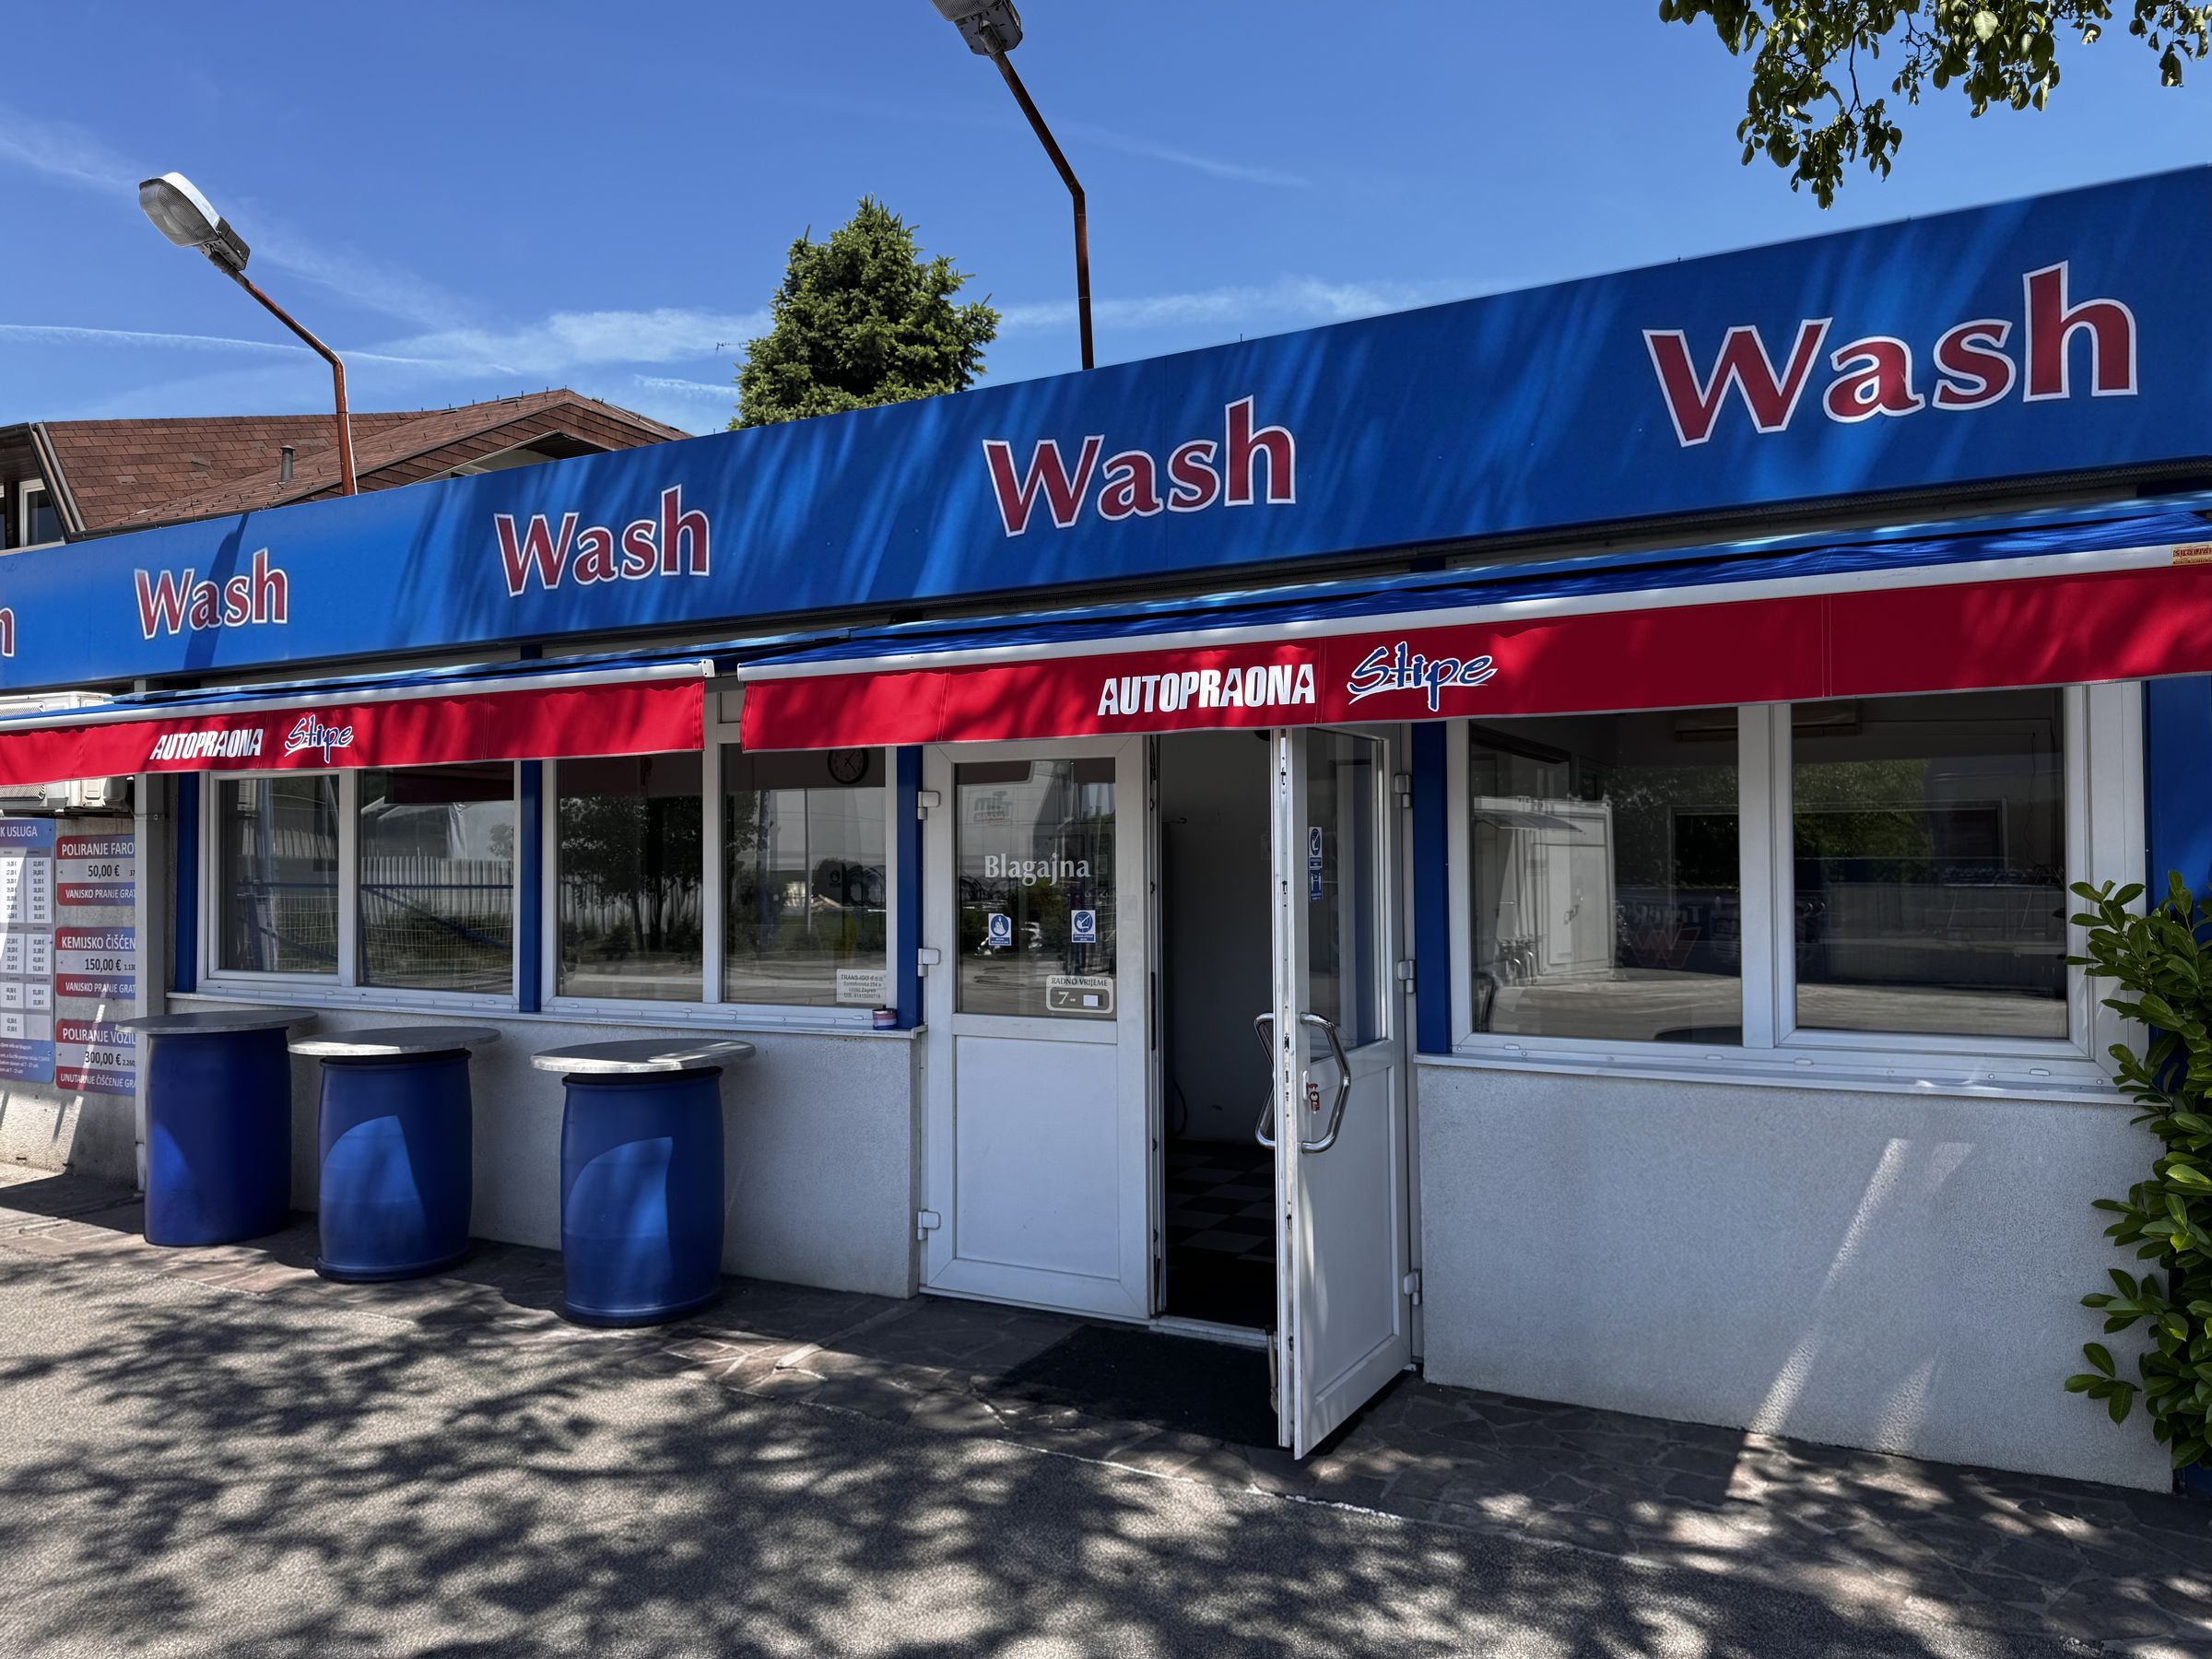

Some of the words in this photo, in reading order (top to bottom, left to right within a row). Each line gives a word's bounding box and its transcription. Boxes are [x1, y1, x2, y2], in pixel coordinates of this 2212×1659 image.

[1642, 261, 2138, 448] Wash
[982, 394, 1296, 537] Wash
[494, 484, 710, 597] Wash
[134, 547, 288, 640] Wash
[1098, 664, 1316, 716] AUTOPRAONA
[1347, 641, 1499, 712] Stipe
[149, 728, 264, 760] AUTOPRAONA
[284, 714, 354, 764] Stipe
[6, 826, 38, 838] USLUGA
[62, 842, 108, 856] POLIRANJE
[111, 841, 135, 855] FARO
[88, 865, 112, 878] 50,00
[114, 865, 120, 877] €
[984, 853, 1092, 887] Blagajna
[65, 888, 93, 899] VANJSKO
[94, 888, 119, 899] PRANJE
[62, 935, 104, 949] KEMIJSKO
[85, 959, 113, 972] 150,00
[115, 959, 122, 971] €
[65, 982, 93, 992] VANJSKO
[94, 982, 118, 994] PRANJE
[1051, 977, 1077, 985] RADNO
[1078, 978, 1109, 987] VRIJEME
[63, 1028, 109, 1042] POLIRANJE
[85, 1051, 113, 1066] 300,00
[115, 1053, 122, 1065] €
[60, 1073, 95, 1085] UNUTARNJE
[96, 1074, 124, 1088] ČIŠĆENJE
